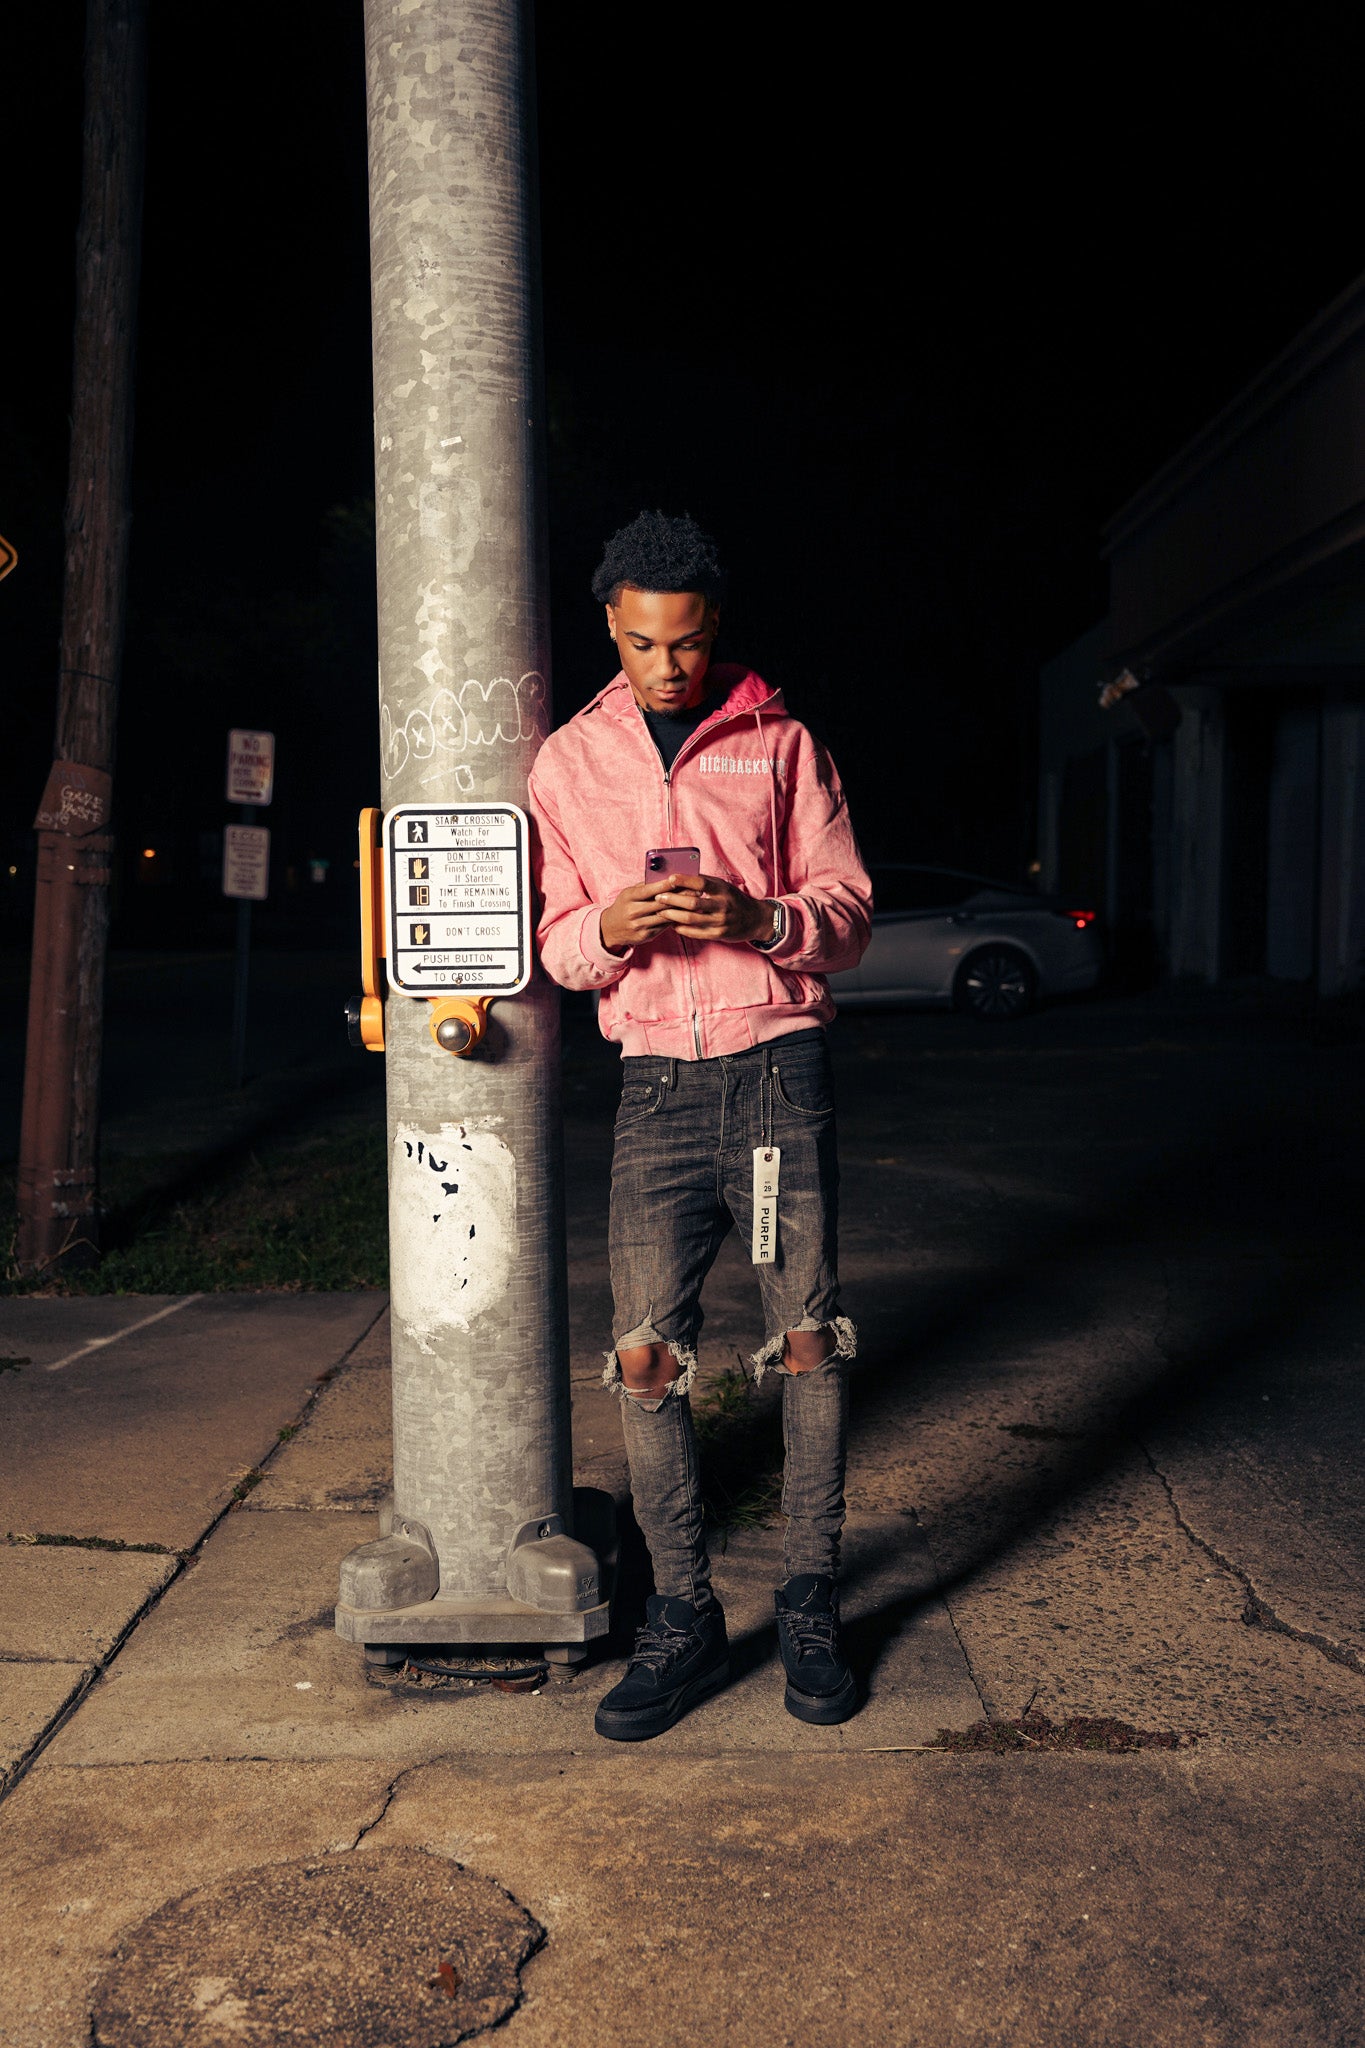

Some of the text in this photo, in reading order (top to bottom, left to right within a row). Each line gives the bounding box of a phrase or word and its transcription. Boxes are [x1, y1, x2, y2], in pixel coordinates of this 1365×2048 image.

[464, 816, 505, 824] CROSSING
[451, 828, 489, 836] Watch For
[456, 838, 486, 846] Vehicles
[476, 852, 500, 860] START
[445, 864, 503, 874] Finish Crossing
[465, 874, 493, 882] Started
[440, 888, 509, 896] TIME REMAINING
[439, 899, 510, 909] To Finish Crossing
[446, 927, 500, 936] DON'T CROSS
[423, 954, 493, 963] PUSH BUTTON
[434, 972, 483, 982] TO CROSS
[760, 1207, 769, 1259] PURPLE
